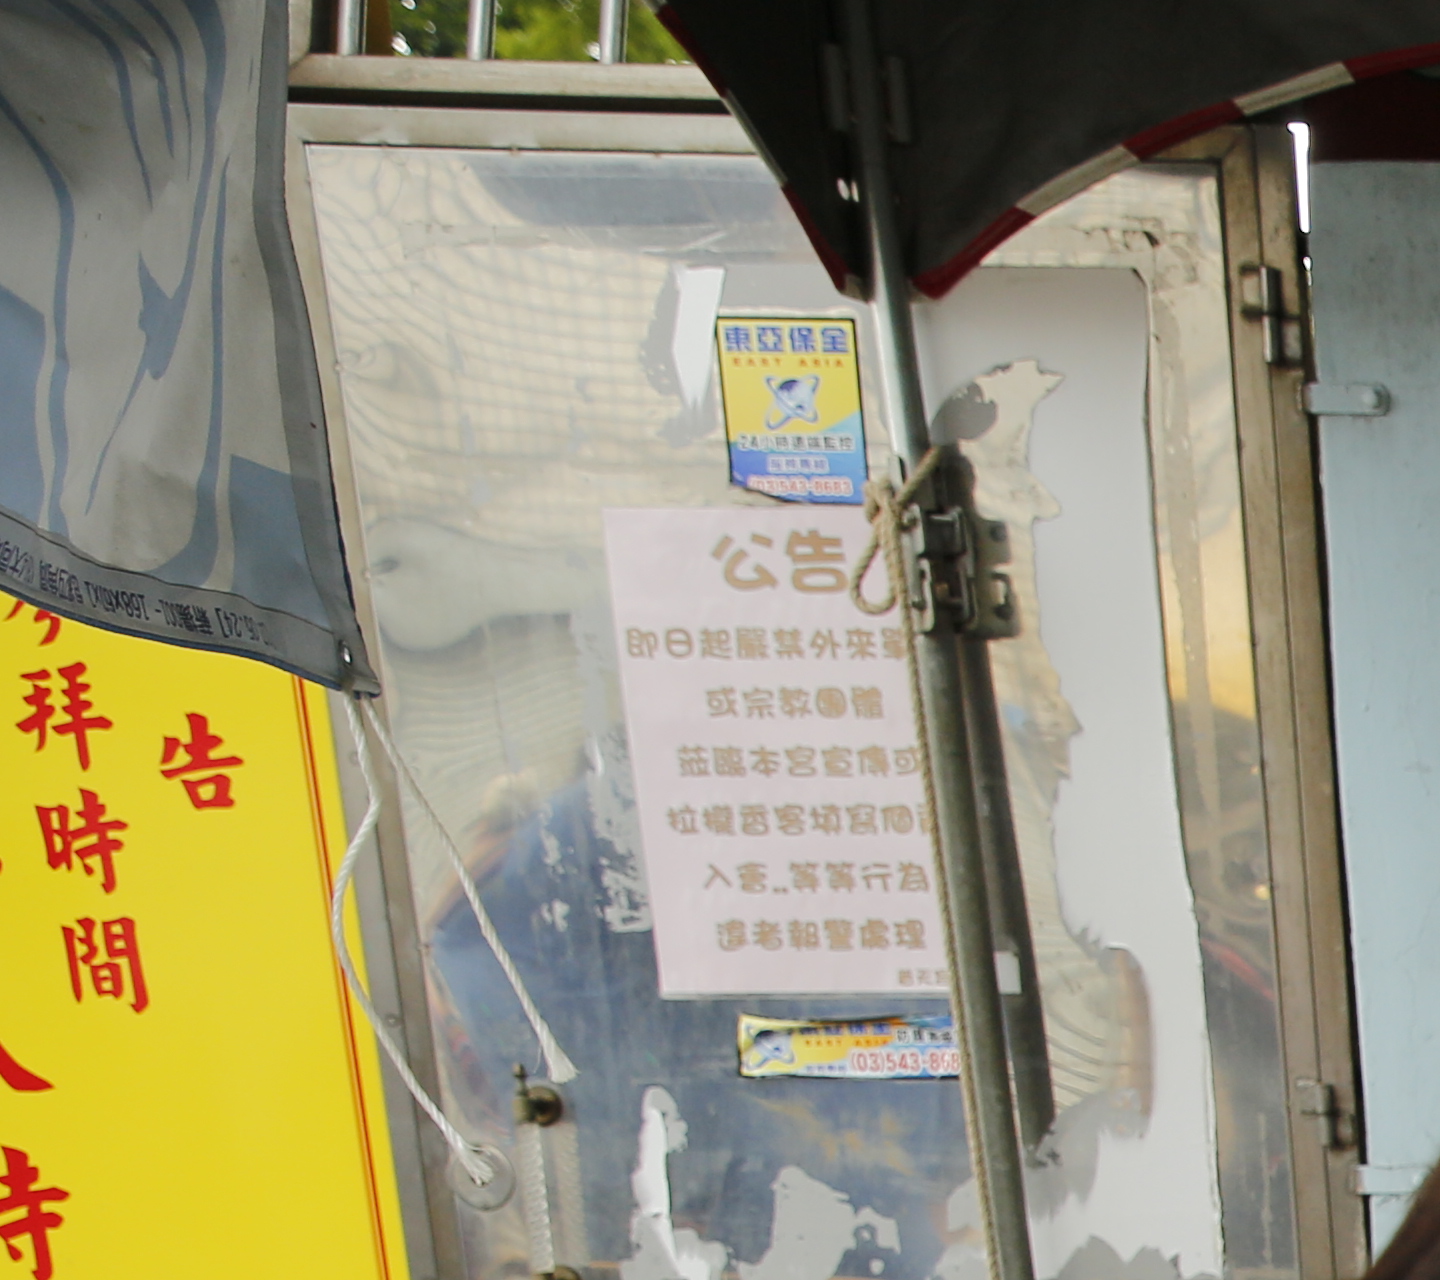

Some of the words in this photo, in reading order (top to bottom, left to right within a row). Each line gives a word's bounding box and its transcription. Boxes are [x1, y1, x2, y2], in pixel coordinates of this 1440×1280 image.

[723, 326, 849, 353] 東亞保全
[710, 529, 850, 594] 公告
[4, 600, 151, 1014] 拜時間
